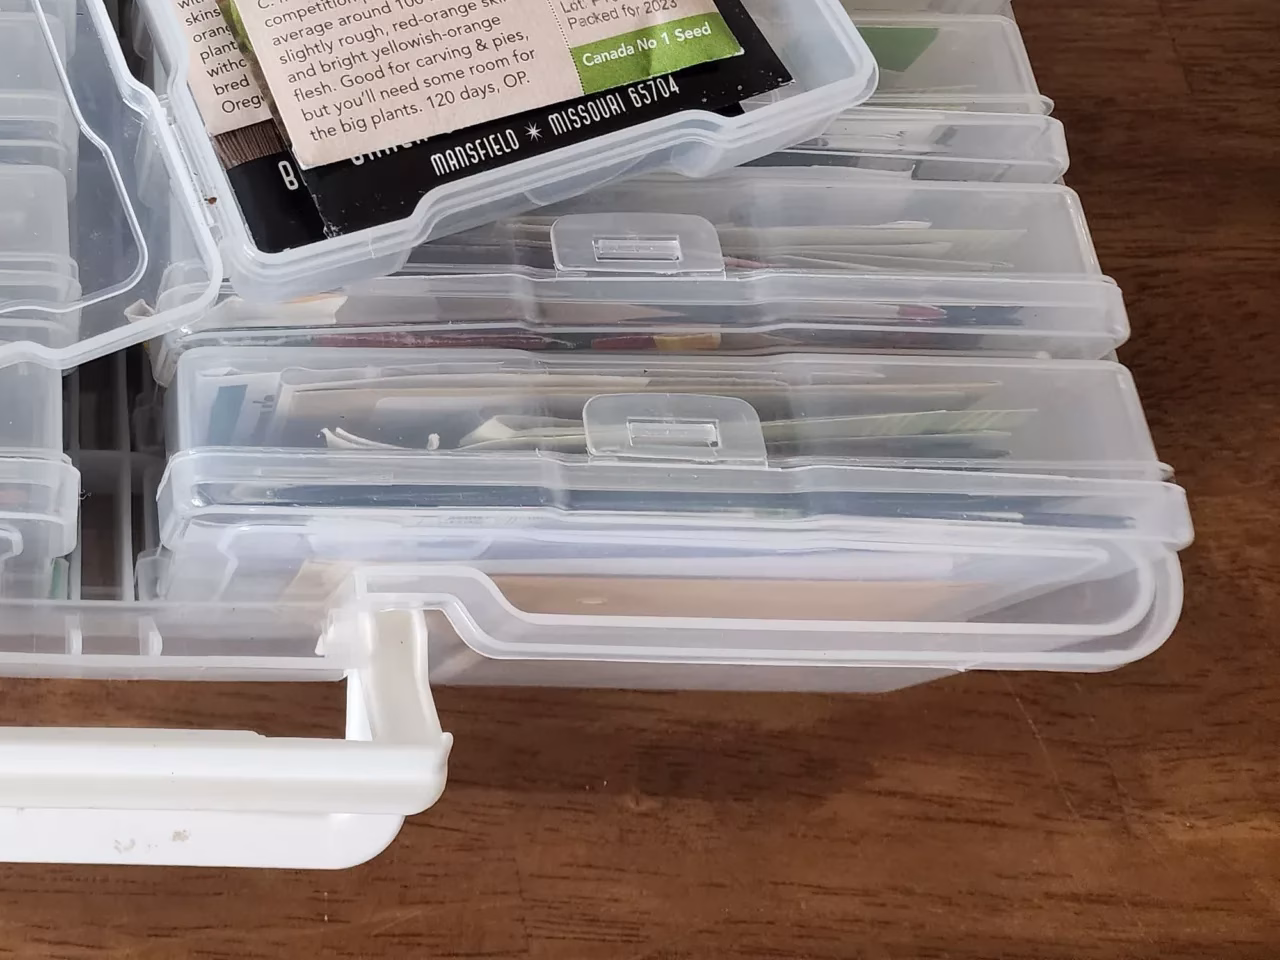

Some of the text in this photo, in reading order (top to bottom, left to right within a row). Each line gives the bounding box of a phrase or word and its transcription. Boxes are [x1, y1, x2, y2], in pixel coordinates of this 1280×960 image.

[185, 8, 221, 26] skins
[271, 20, 334, 47] average
[338, 2, 393, 27] around
[560, 0, 589, 14] Lot:
[567, 7, 620, 30] Packed
[621, 3, 641, 17] for
[278, 39, 334, 66] slightly
[338, 25, 390, 47] rough,
[392, 0, 478, 34] red-orange
[287, 15, 503, 84] and bright yellowish-orange
[582, 21, 712, 67] Canada No 1 Seed
[213, 73, 250, 96] bred
[293, 32, 530, 103] flesh. Good for carving & pies,
[300, 103, 332, 122] but
[379, 79, 421, 98] need
[423, 69, 467, 89] some
[468, 57, 511, 77] room
[512, 47, 538, 65] for
[222, 94, 265, 114] Oreg
[308, 70, 532, 142] the big plants. 120 days, OP.
[430, 128, 520, 177] MANSFIELD
[547, 93, 628, 136] MISSOURI
[628, 75, 680, 108] 65704
